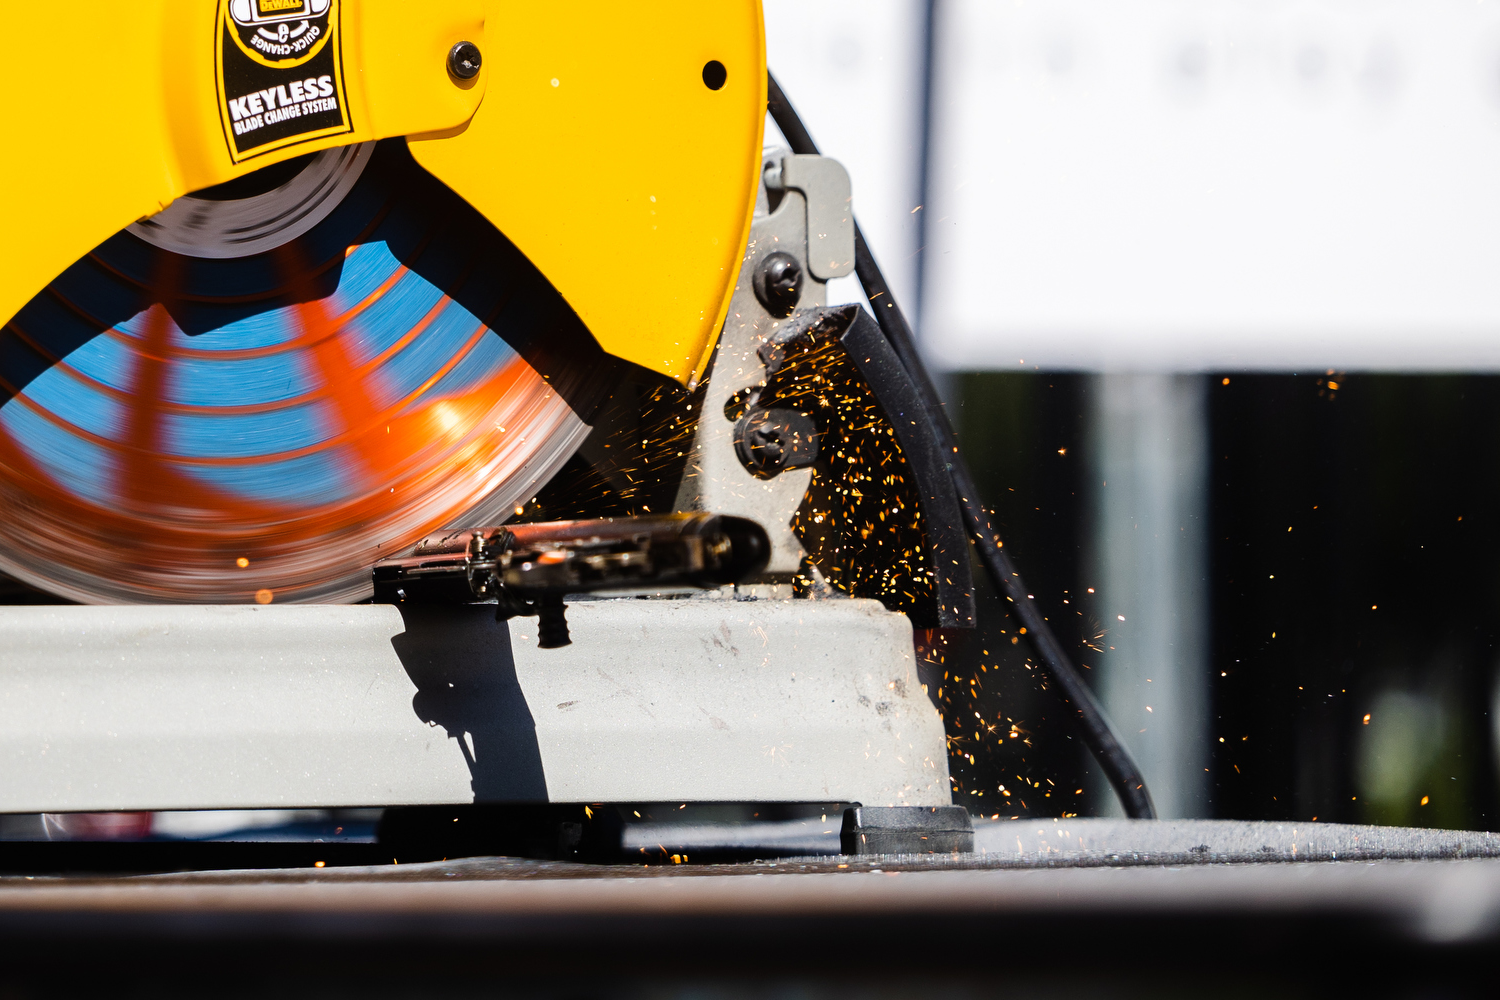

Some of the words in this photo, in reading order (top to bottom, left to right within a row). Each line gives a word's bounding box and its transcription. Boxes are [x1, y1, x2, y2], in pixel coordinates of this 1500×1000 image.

[250, 25, 320, 55] QUICK-CHANGE
[228, 74, 334, 121] KEYLESS
[233, 114, 264, 135] BLADE
[263, 104, 301, 125] CHANGE
[301, 96, 337, 115] SYSTEM
